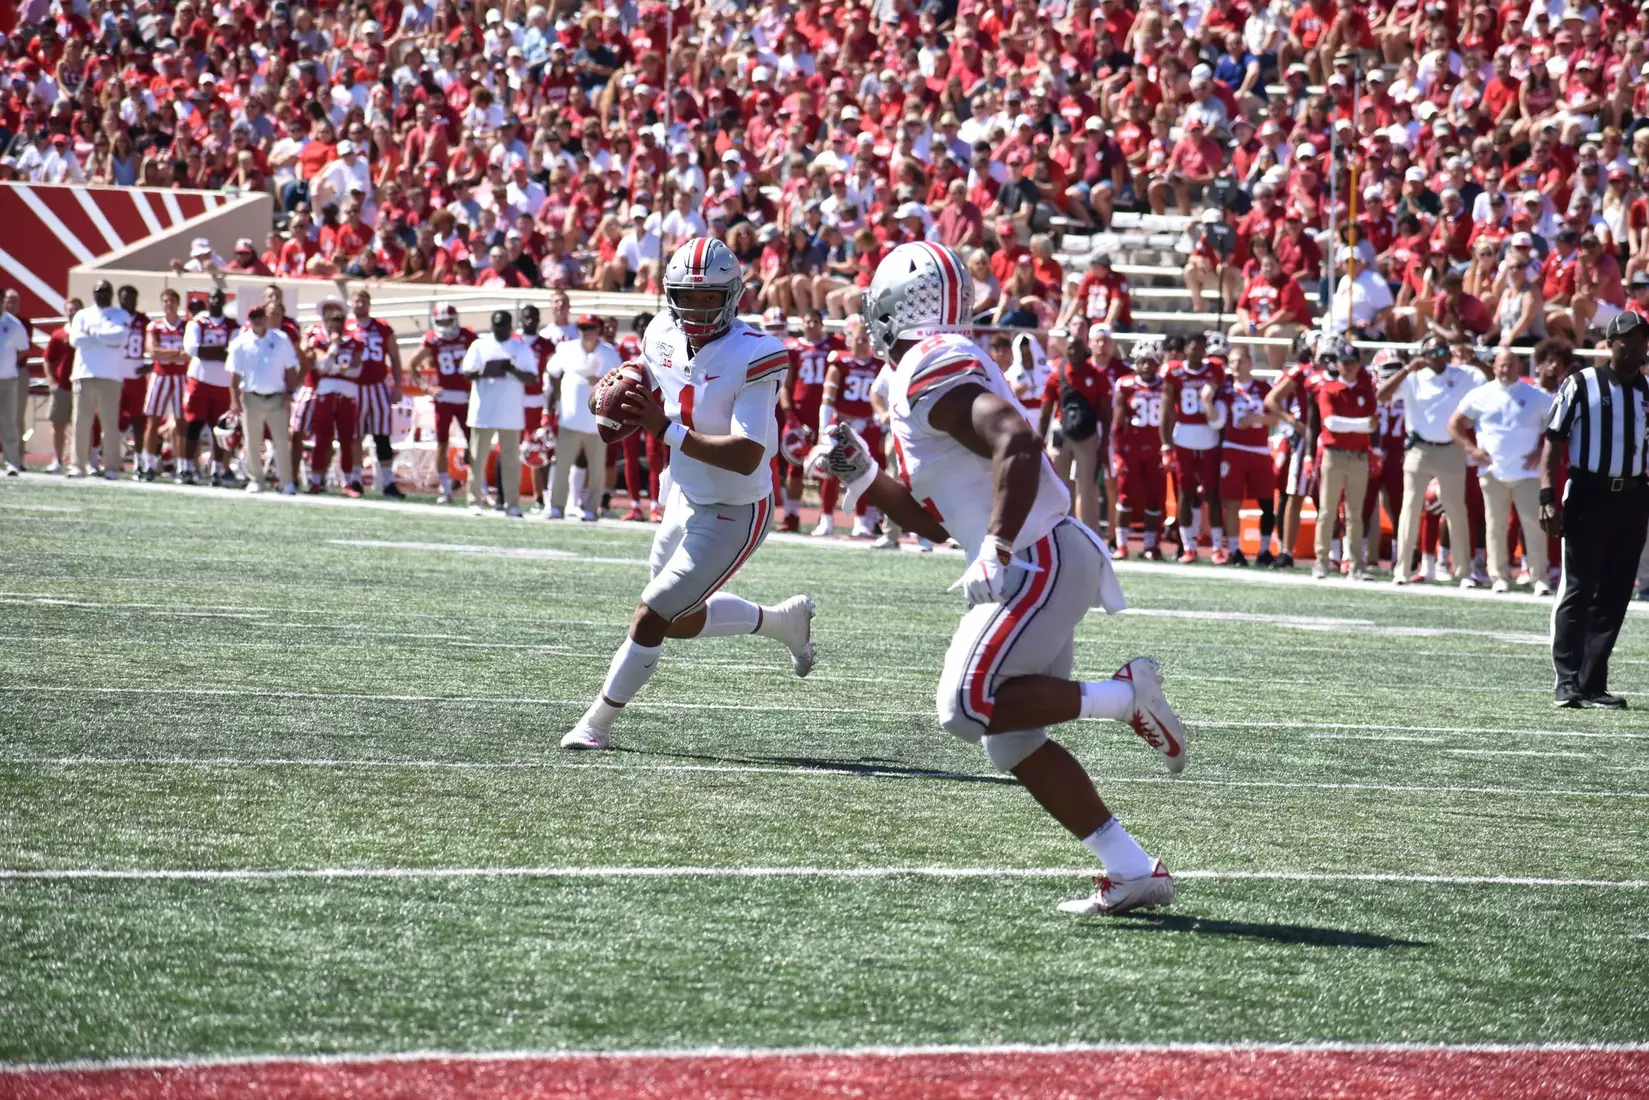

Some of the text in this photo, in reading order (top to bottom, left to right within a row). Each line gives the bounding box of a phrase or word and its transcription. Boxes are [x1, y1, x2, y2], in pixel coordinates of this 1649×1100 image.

[799, 358, 826, 384] 41
[679, 384, 697, 431] 1
[1130, 397, 1162, 427] 38
